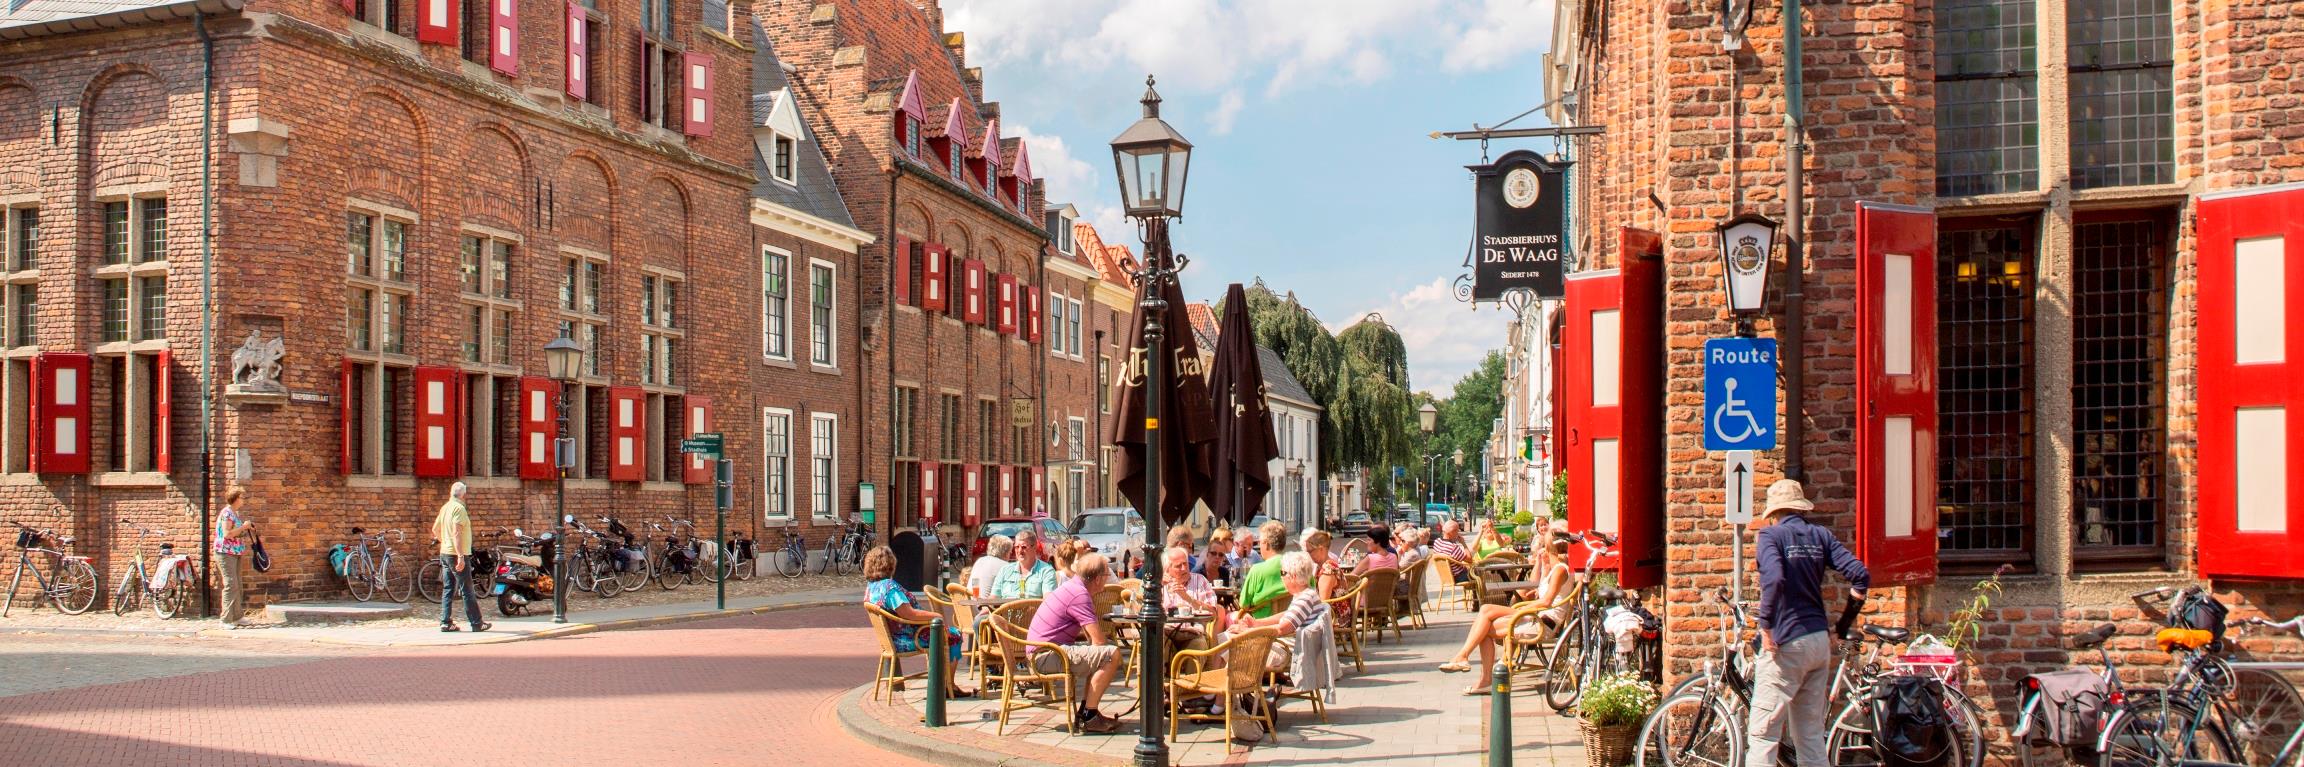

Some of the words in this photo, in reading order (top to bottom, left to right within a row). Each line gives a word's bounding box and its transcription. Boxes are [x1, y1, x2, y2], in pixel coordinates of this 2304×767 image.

[1483, 234, 1558, 246] STADSBIERHUYS
[1483, 248, 1506, 263] DE
[1508, 246, 1558, 263] WAAG
[1501, 271, 1525, 279] SEDERT
[1712, 347, 1770, 365] Route
